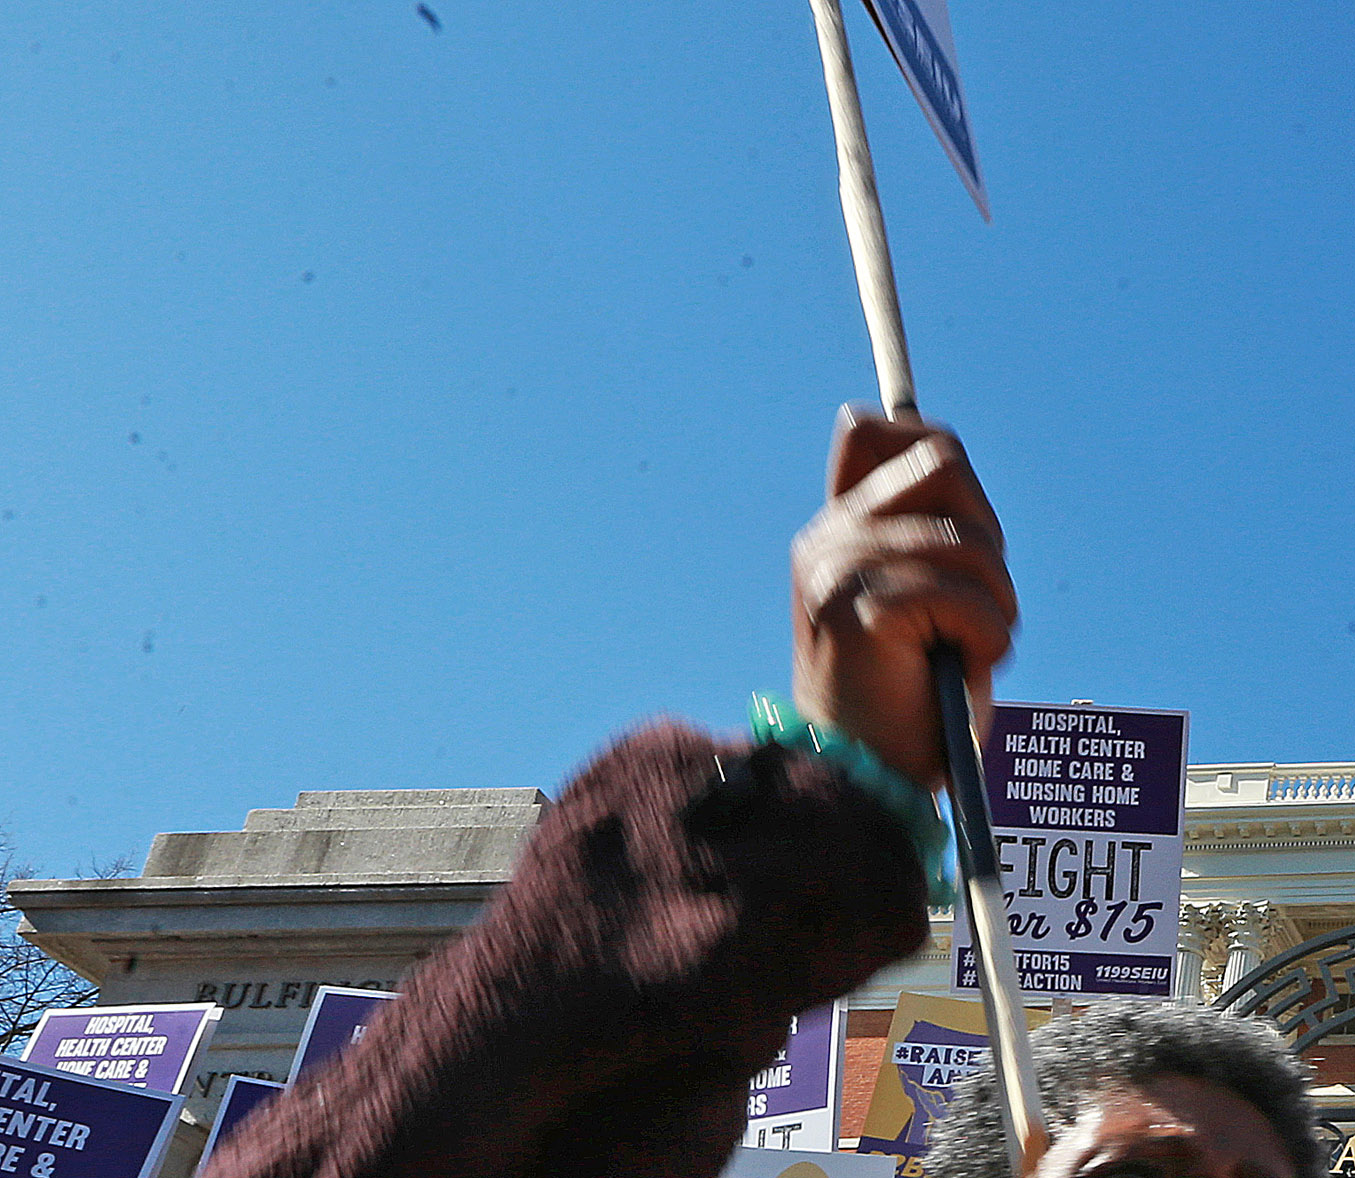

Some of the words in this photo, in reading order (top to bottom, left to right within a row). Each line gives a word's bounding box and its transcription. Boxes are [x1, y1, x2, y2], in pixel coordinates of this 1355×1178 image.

[1032, 712, 1121, 737] HOSPITAL,
[1005, 735, 1072, 755] HEALTH
[1077, 738, 1145, 760] CENTER
[1014, 757, 1062, 779] HOME
[1068, 760, 1115, 781] CARE
[1121, 763, 1135, 782] &
[1006, 781, 1086, 804] NURSING
[1091, 784, 1140, 807] HOME
[1029, 806, 1116, 829] WORKERS
[1066, 897, 1163, 943] $15
[1095, 966, 1168, 980] 1199SEIU
[84, 1014, 154, 1036] HOSPITAL,
[55, 1039, 110, 1058] HEALTH
[111, 1036, 167, 1057] CENTER
[99, 1060, 135, 1080] CARE
[136, 1060, 150, 1080] &
[0, 1109, 90, 1151] ENTER
